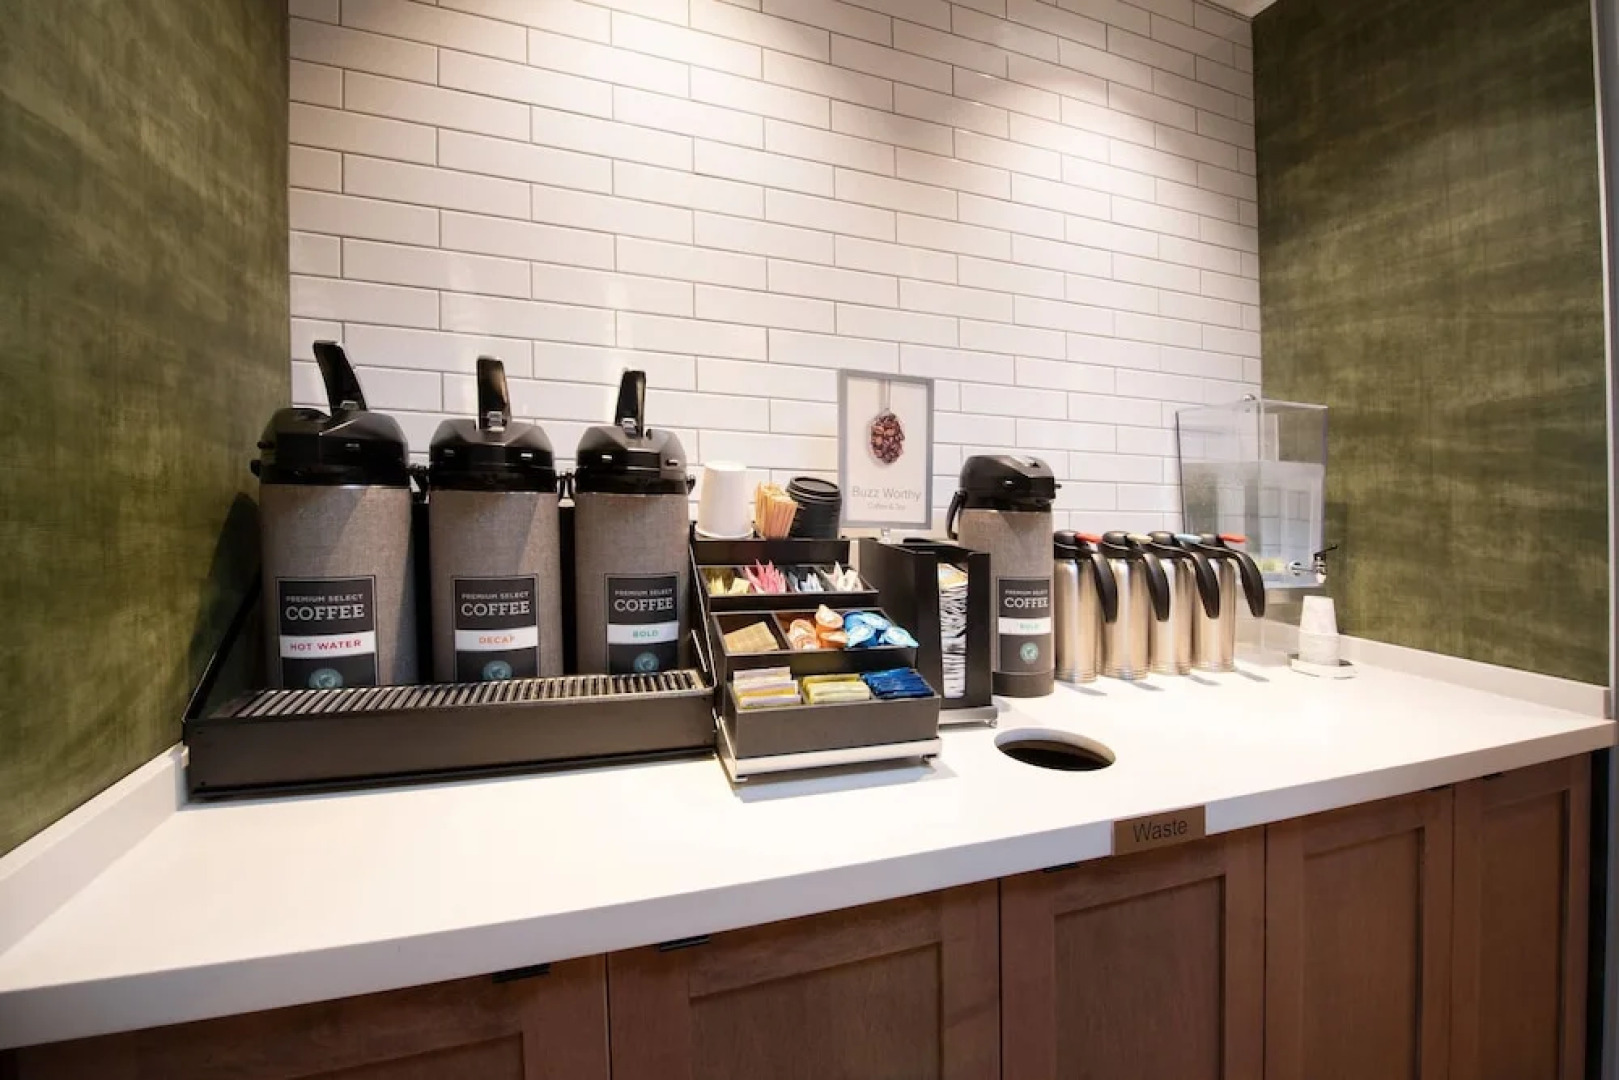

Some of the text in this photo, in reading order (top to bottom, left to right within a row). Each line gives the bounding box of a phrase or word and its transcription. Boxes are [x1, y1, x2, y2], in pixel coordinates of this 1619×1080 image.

[852, 486, 921, 502] Buzz Worthy
[328, 593, 364, 602] SELECT
[500, 590, 529, 600] SELECT
[650, 588, 673, 596] SELECT
[614, 597, 674, 612] COFFEE
[1004, 596, 1048, 608] COFFEE
[285, 603, 365, 621] COFFEE
[461, 600, 530, 616] COFFEE
[479, 635, 515, 644] DECAF
[633, 630, 659, 638] BOLD
[290, 640, 361, 651] HOT WATER
[1132, 818, 1188, 843] Waste
